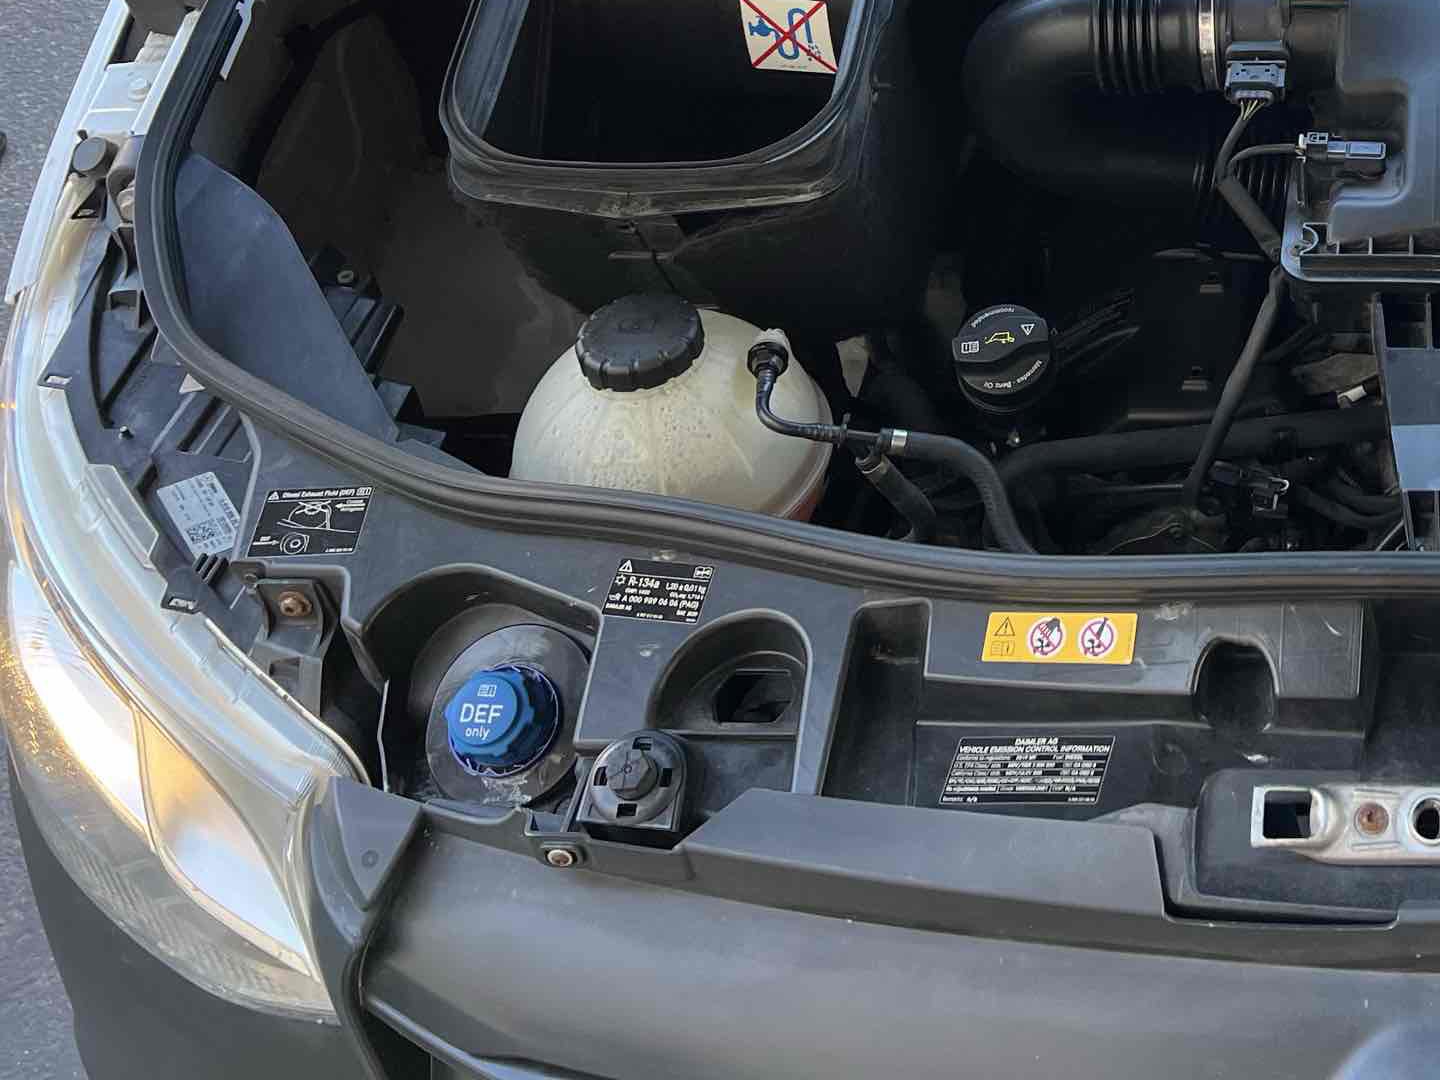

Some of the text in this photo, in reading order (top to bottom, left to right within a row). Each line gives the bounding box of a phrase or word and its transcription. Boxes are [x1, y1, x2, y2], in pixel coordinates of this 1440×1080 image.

[627, 576, 660, 589] R-134a
[628, 595, 643, 604] 000
[460, 703, 504, 724] DEF
[465, 726, 490, 741] only
[1015, 738, 1047, 746] DAIMLER
[1060, 745, 1111, 753] INFORMATION
